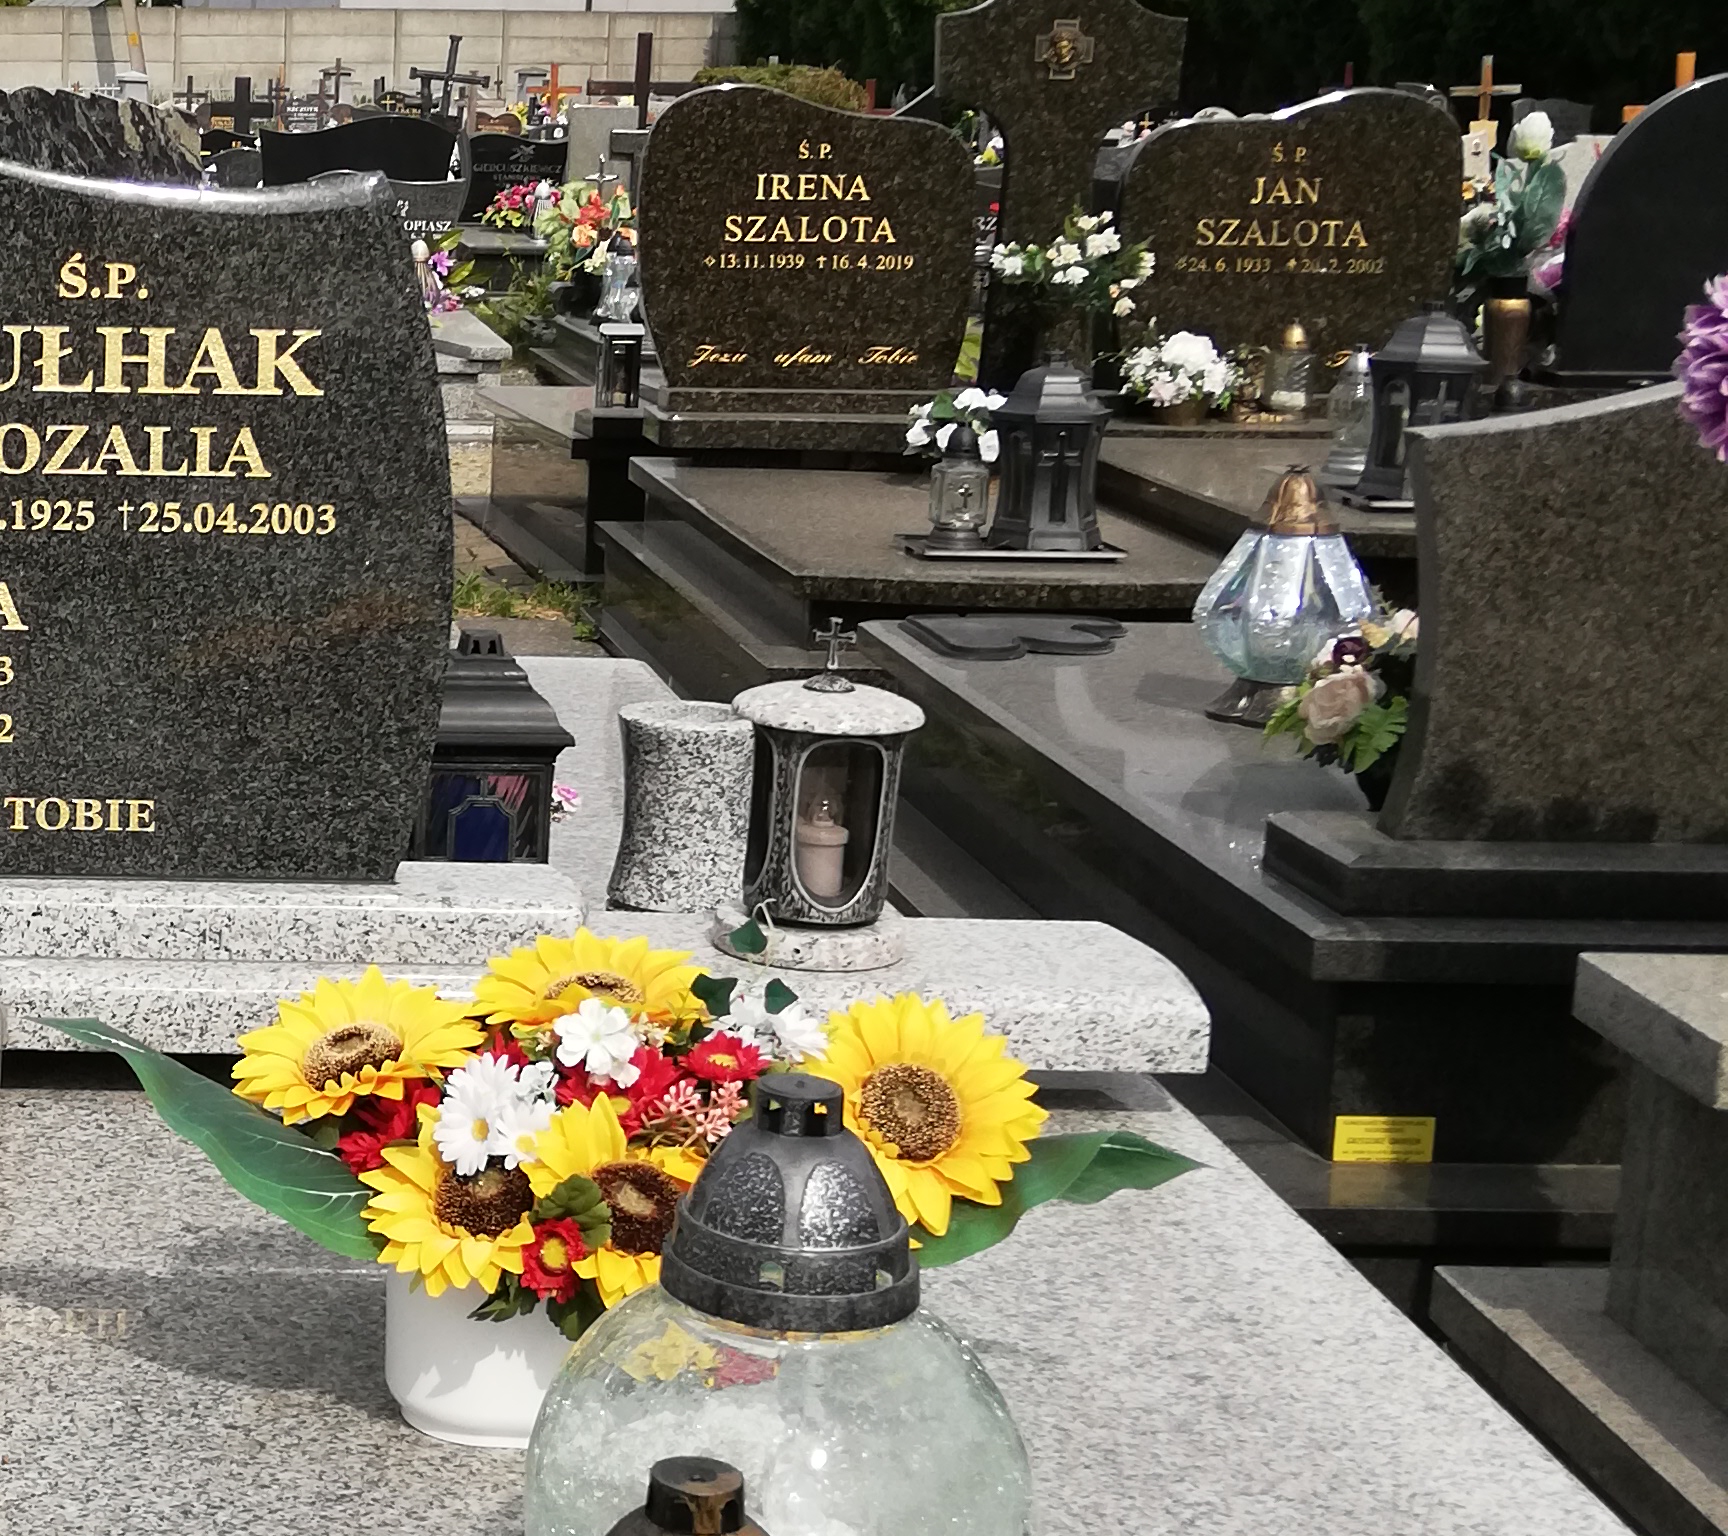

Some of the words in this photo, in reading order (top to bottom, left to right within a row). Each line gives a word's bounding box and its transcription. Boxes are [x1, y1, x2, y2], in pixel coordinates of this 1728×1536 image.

[755, 173, 872, 201] IRENA
[1249, 175, 1323, 205] JAN
[724, 215, 897, 243] SZALOTA
[1196, 218, 1369, 248] SZALOTA
[687, 344, 749, 368] Jezu
[773, 343, 833, 368] ufam
[857, 346, 920, 365] Tobie
[4, 797, 156, 833] TOBIE
